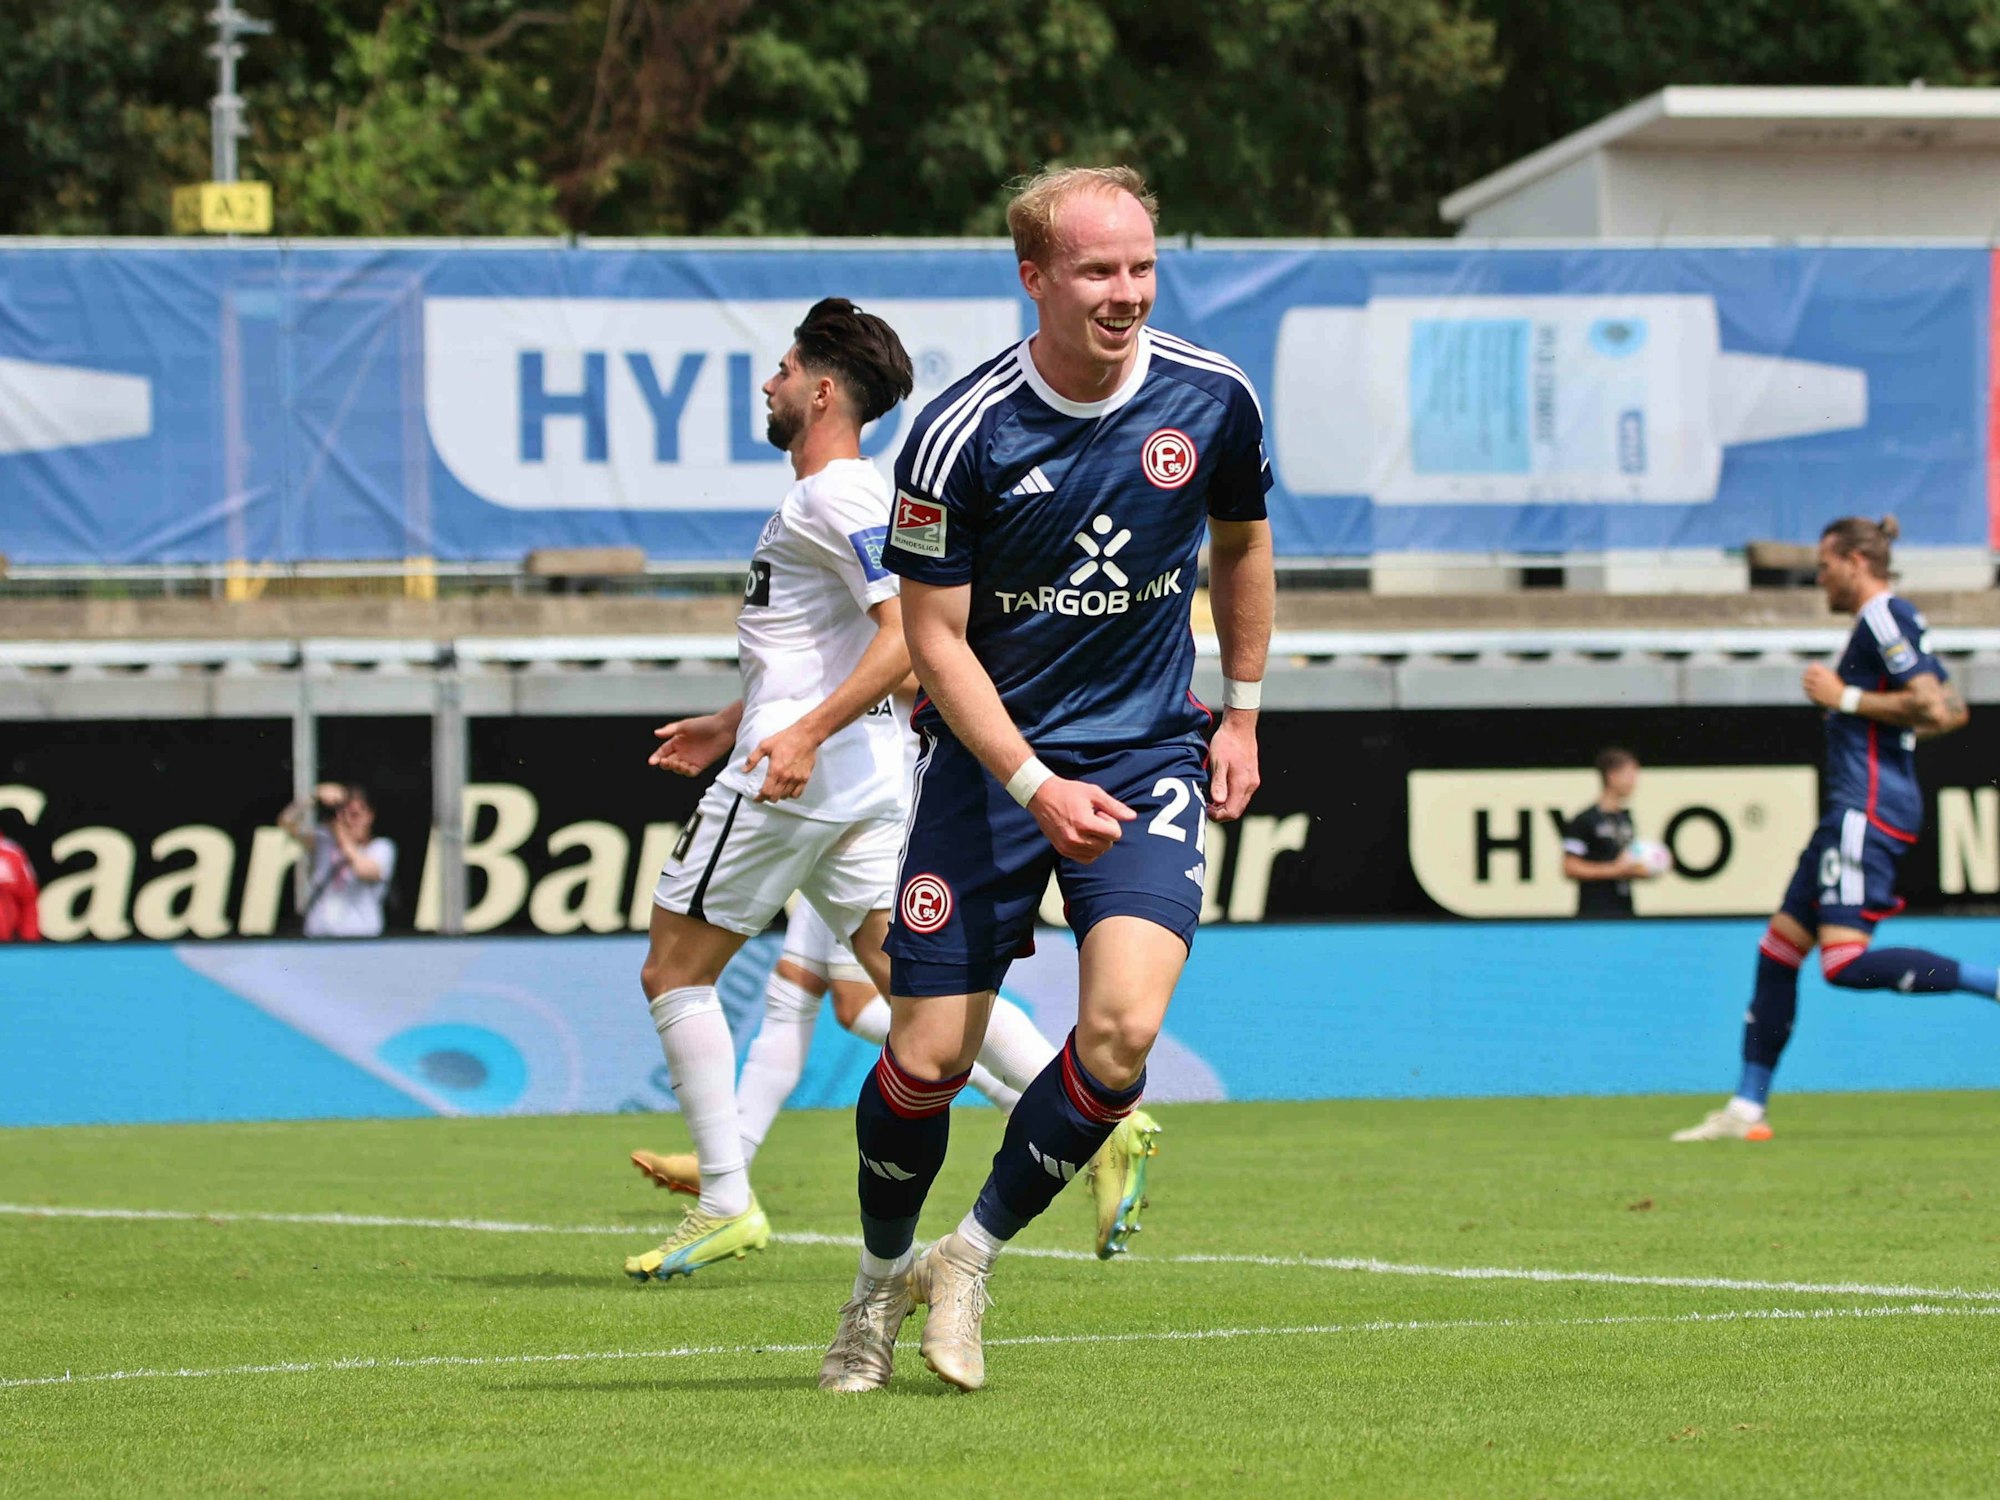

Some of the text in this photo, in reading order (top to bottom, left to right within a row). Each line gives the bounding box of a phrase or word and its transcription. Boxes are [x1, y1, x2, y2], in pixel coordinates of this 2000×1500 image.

[518, 350, 900, 463] HYL
[895, 535, 940, 553] BUNDESLIGA
[0, 784, 303, 941] aar
[1474, 806, 1733, 882] HO
